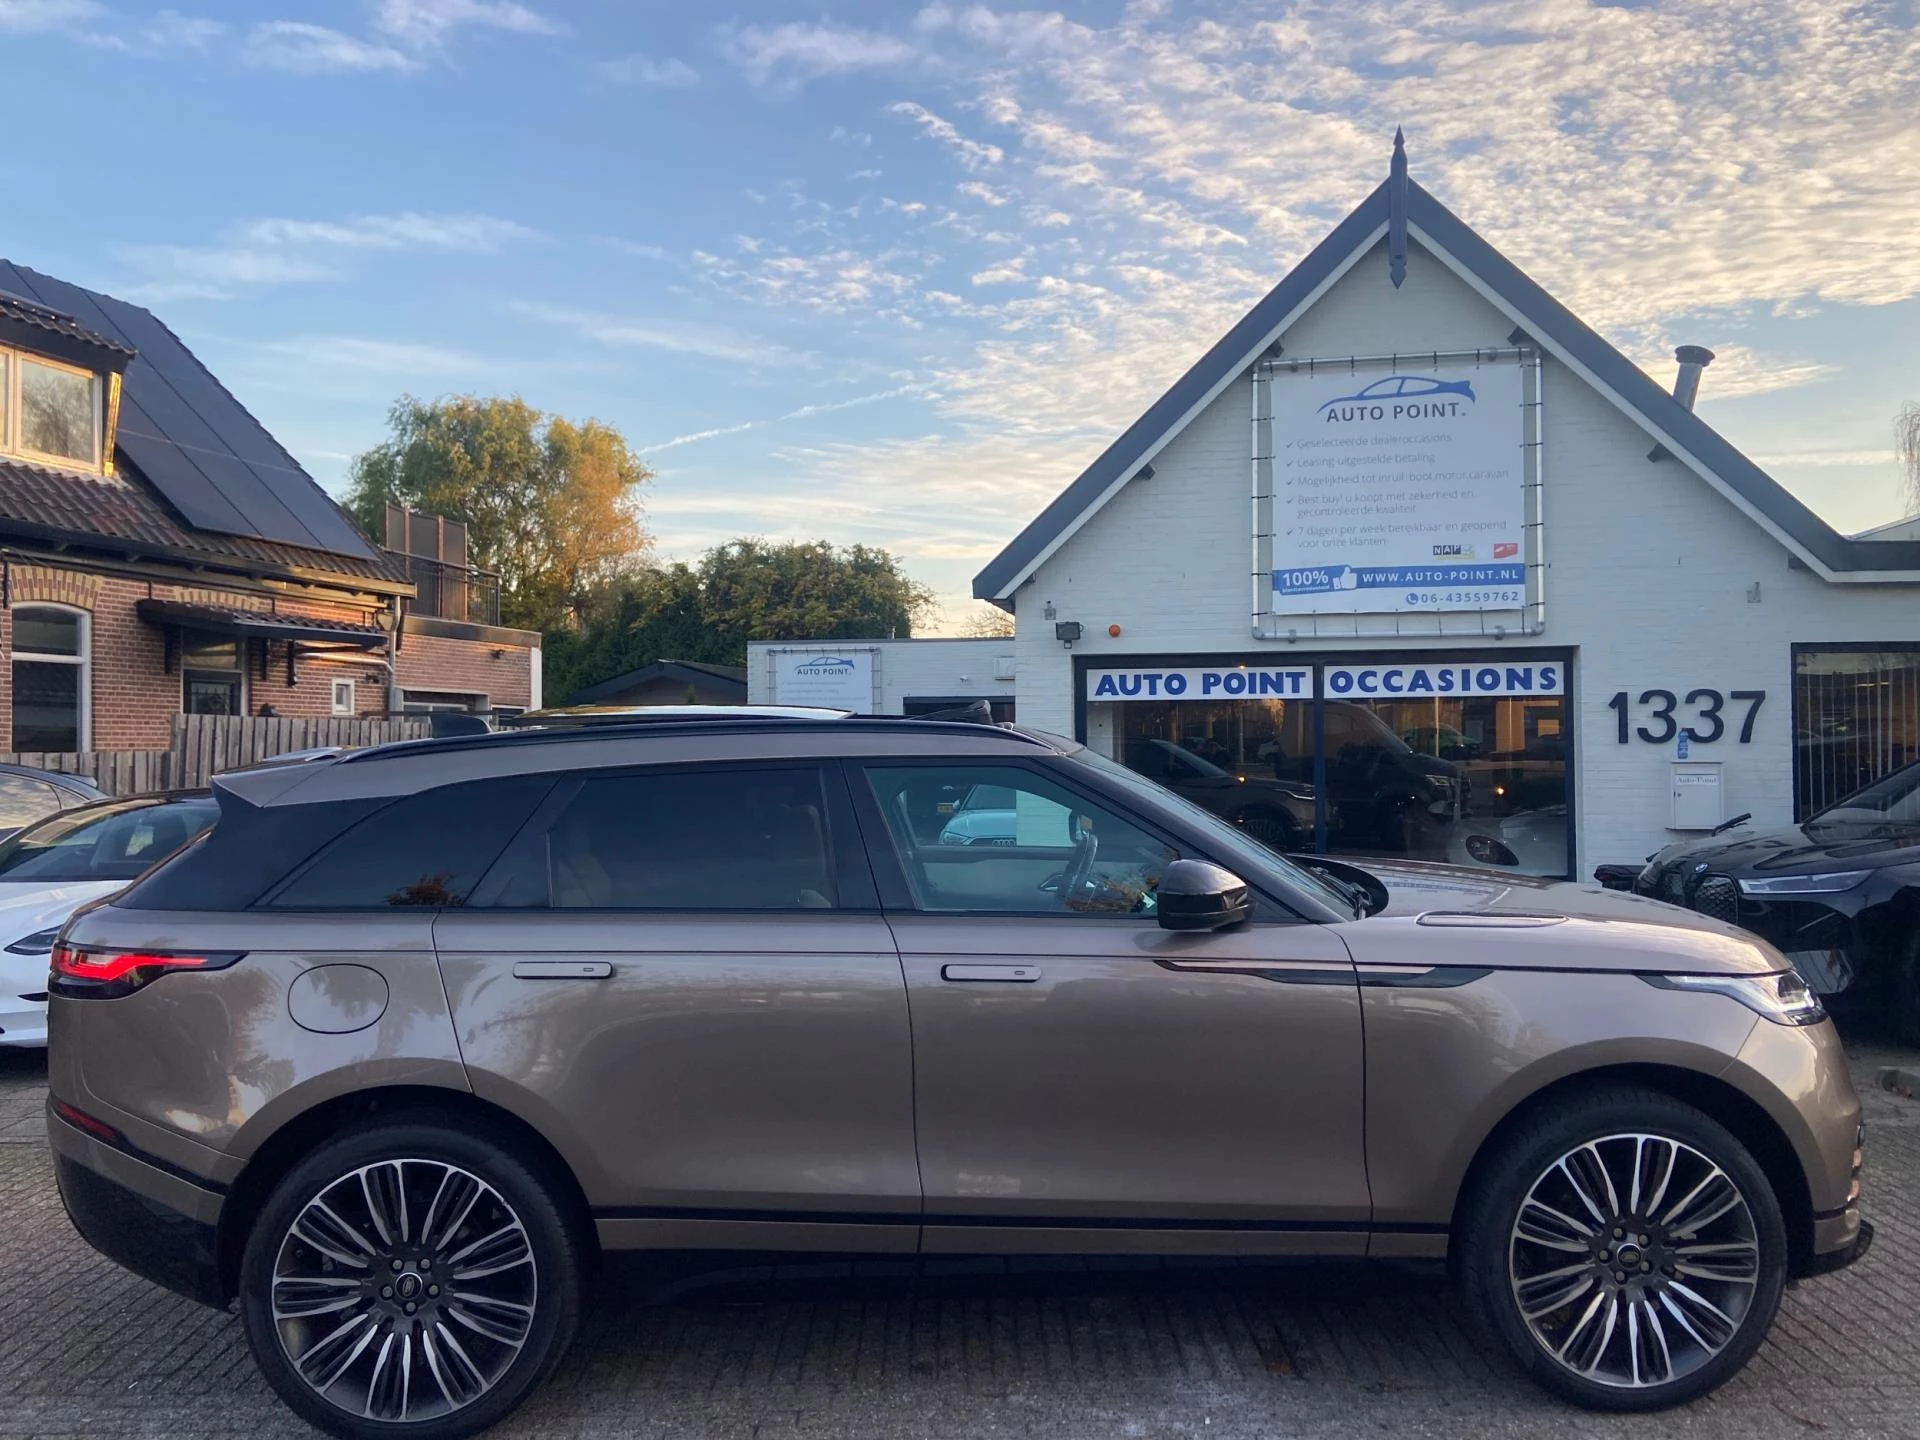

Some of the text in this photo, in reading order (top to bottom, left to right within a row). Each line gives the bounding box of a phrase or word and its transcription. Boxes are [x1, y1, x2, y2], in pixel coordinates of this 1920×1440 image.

[1326, 406, 1384, 422] AUTO
[1297, 437, 1368, 448] Geselecteerde
[1395, 453, 1436, 464] betaling
[1298, 475, 1359, 487] Mogelijkheid
[1361, 474, 1376, 482] tot
[1298, 495, 1319, 504] Best
[1355, 492, 1382, 504] koopt
[1386, 493, 1405, 501] met
[1409, 490, 1458, 500] zekerheid
[1297, 503, 1416, 519] gecontroleerde kwaliteit
[1298, 520, 1506, 537] 7 dagen per week bereikbaar en geopend
[1298, 536, 1386, 548] voor onze klanten
[1433, 544, 1461, 555] NAP
[1282, 570, 1329, 587] 100%
[1362, 569, 1519, 582] WWW.AUTO-POINT.NL
[1421, 591, 1519, 603] 06-43559762
[1094, 671, 1306, 696] AUTO POINT
[1330, 667, 1557, 693] OCCASIONS
[1608, 689, 1766, 744] 1337
